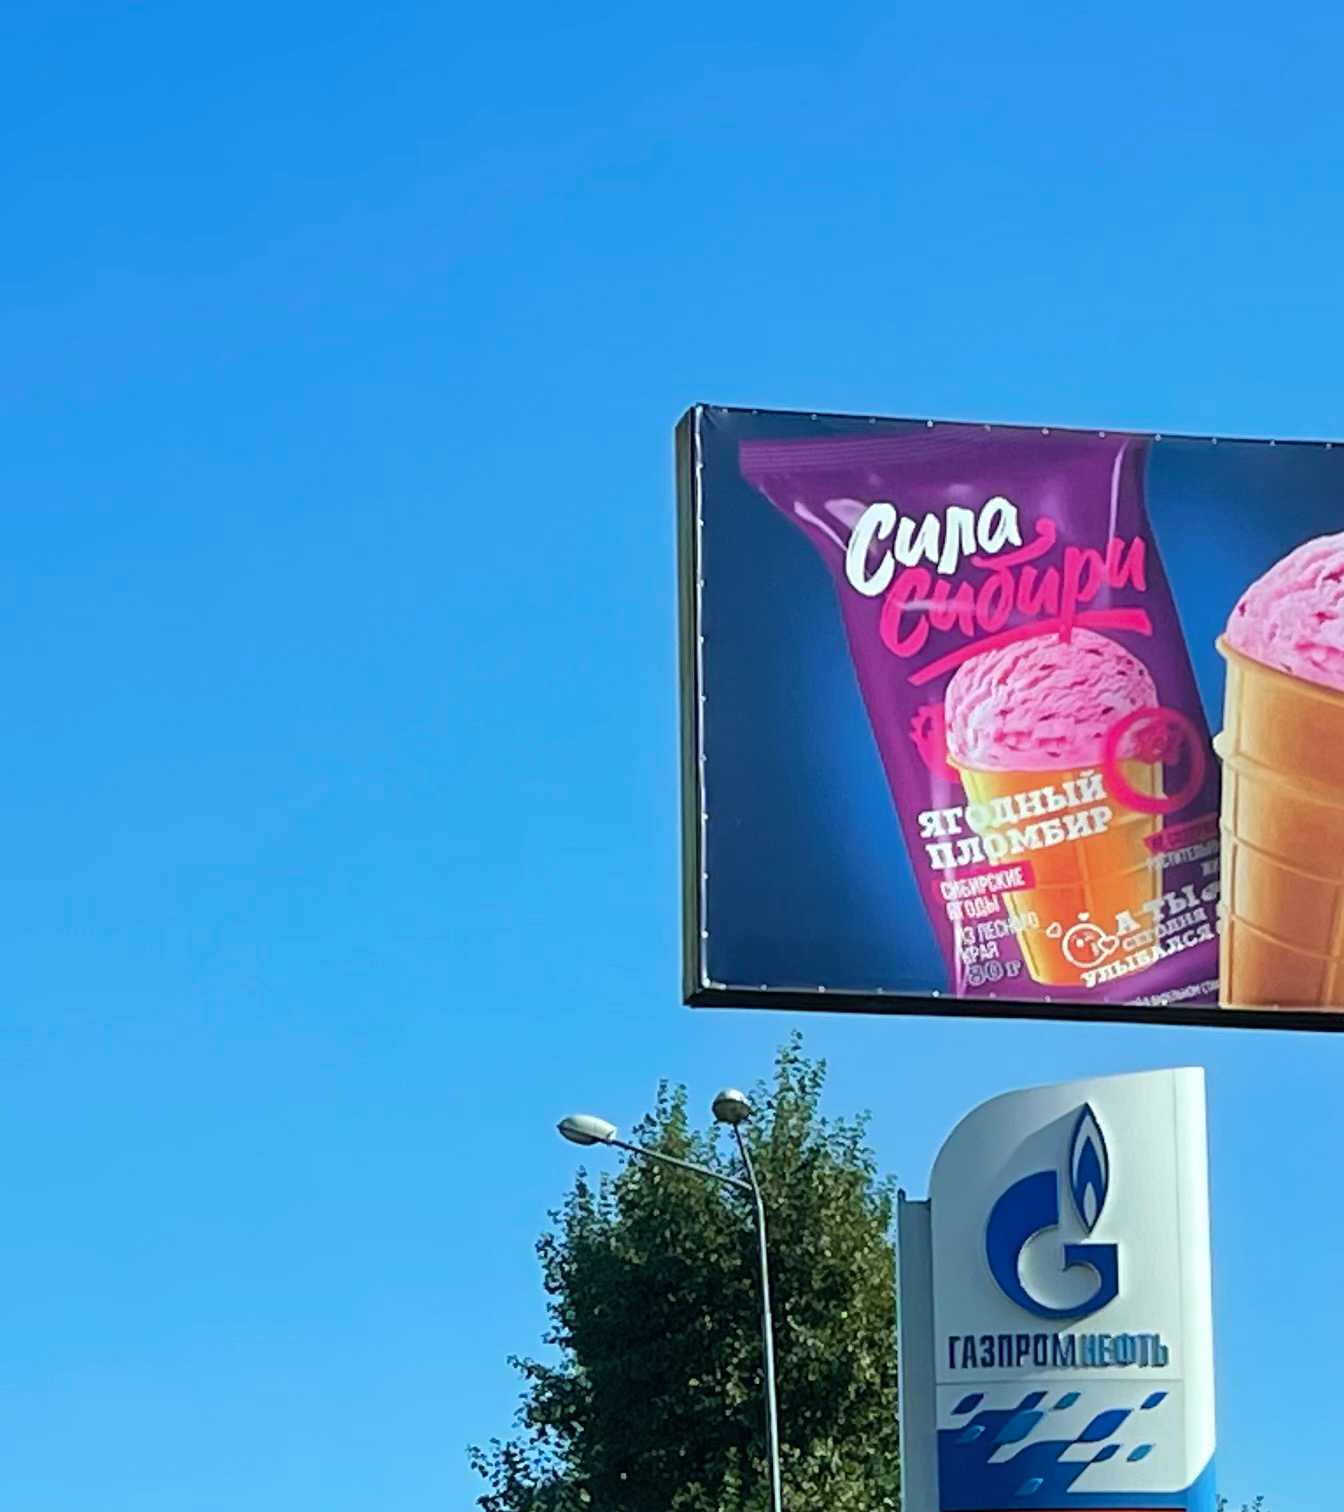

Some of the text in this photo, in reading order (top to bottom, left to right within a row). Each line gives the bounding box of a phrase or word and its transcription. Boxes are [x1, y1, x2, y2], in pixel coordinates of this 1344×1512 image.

[845, 496, 1022, 596] Сила
[880, 518, 1146, 657] Сибири
[918, 769, 1108, 838] ЯГОДНЫЙ
[925, 806, 1113, 870] ПЛОМБИР
[948, 1333, 1169, 1370] ГАЗПРОМНЕФТЬ
